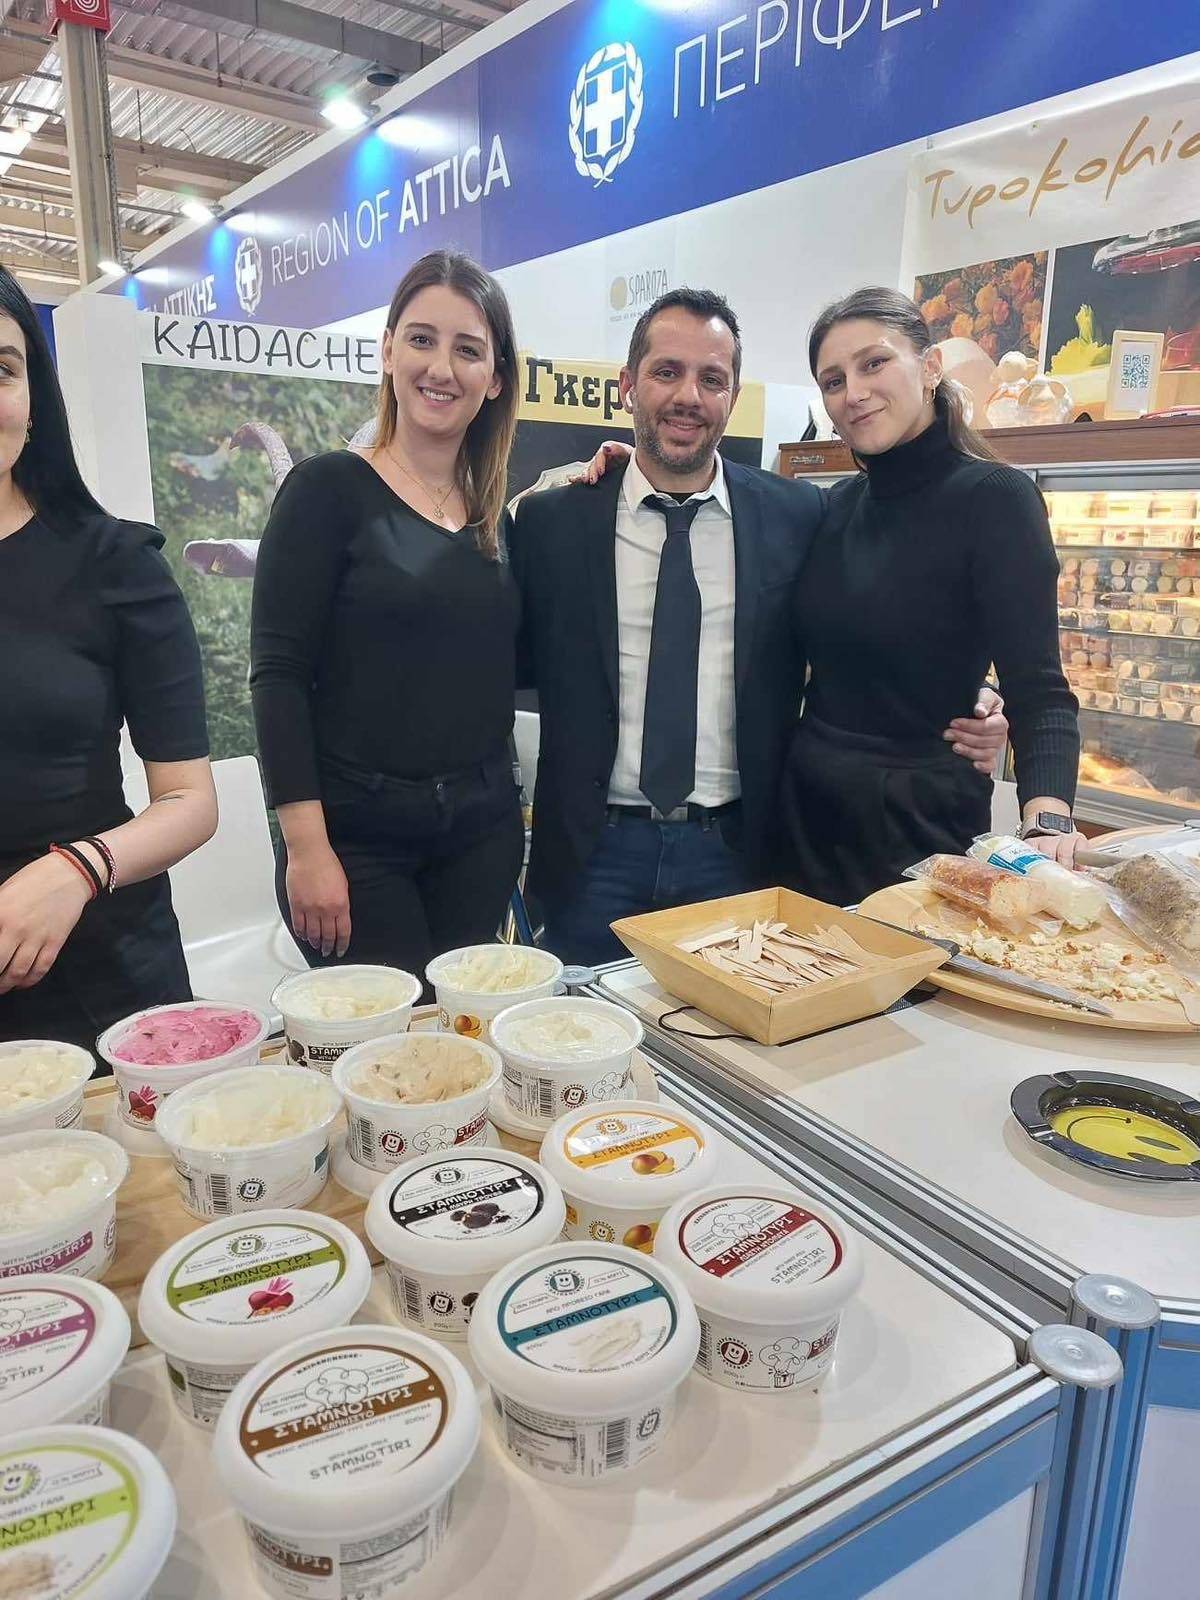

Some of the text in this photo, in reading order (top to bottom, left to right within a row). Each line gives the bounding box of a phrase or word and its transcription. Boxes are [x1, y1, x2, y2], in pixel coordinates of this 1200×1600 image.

[271, 133, 511, 287] REGION OF ATTICA
[154, 315, 379, 375] KAIDACHE
[416, 1180, 512, 1214] ΣΤΑΜΝΟΤΥΡΙ
[716, 1216, 794, 1265] ΣΤΑΜΝΟΤΥΡΙ
[199, 1253, 312, 1291] ΣΤΑΜΝΟΤΥΡΙ
[533, 1295, 640, 1337] ΣΤΑΜΝΟΤΥΡΙ
[273, 1386, 413, 1438] ΣΤΑΜΝΟΤΥΡΙ
[310, 1439, 412, 1480] STAMNOTIRI
